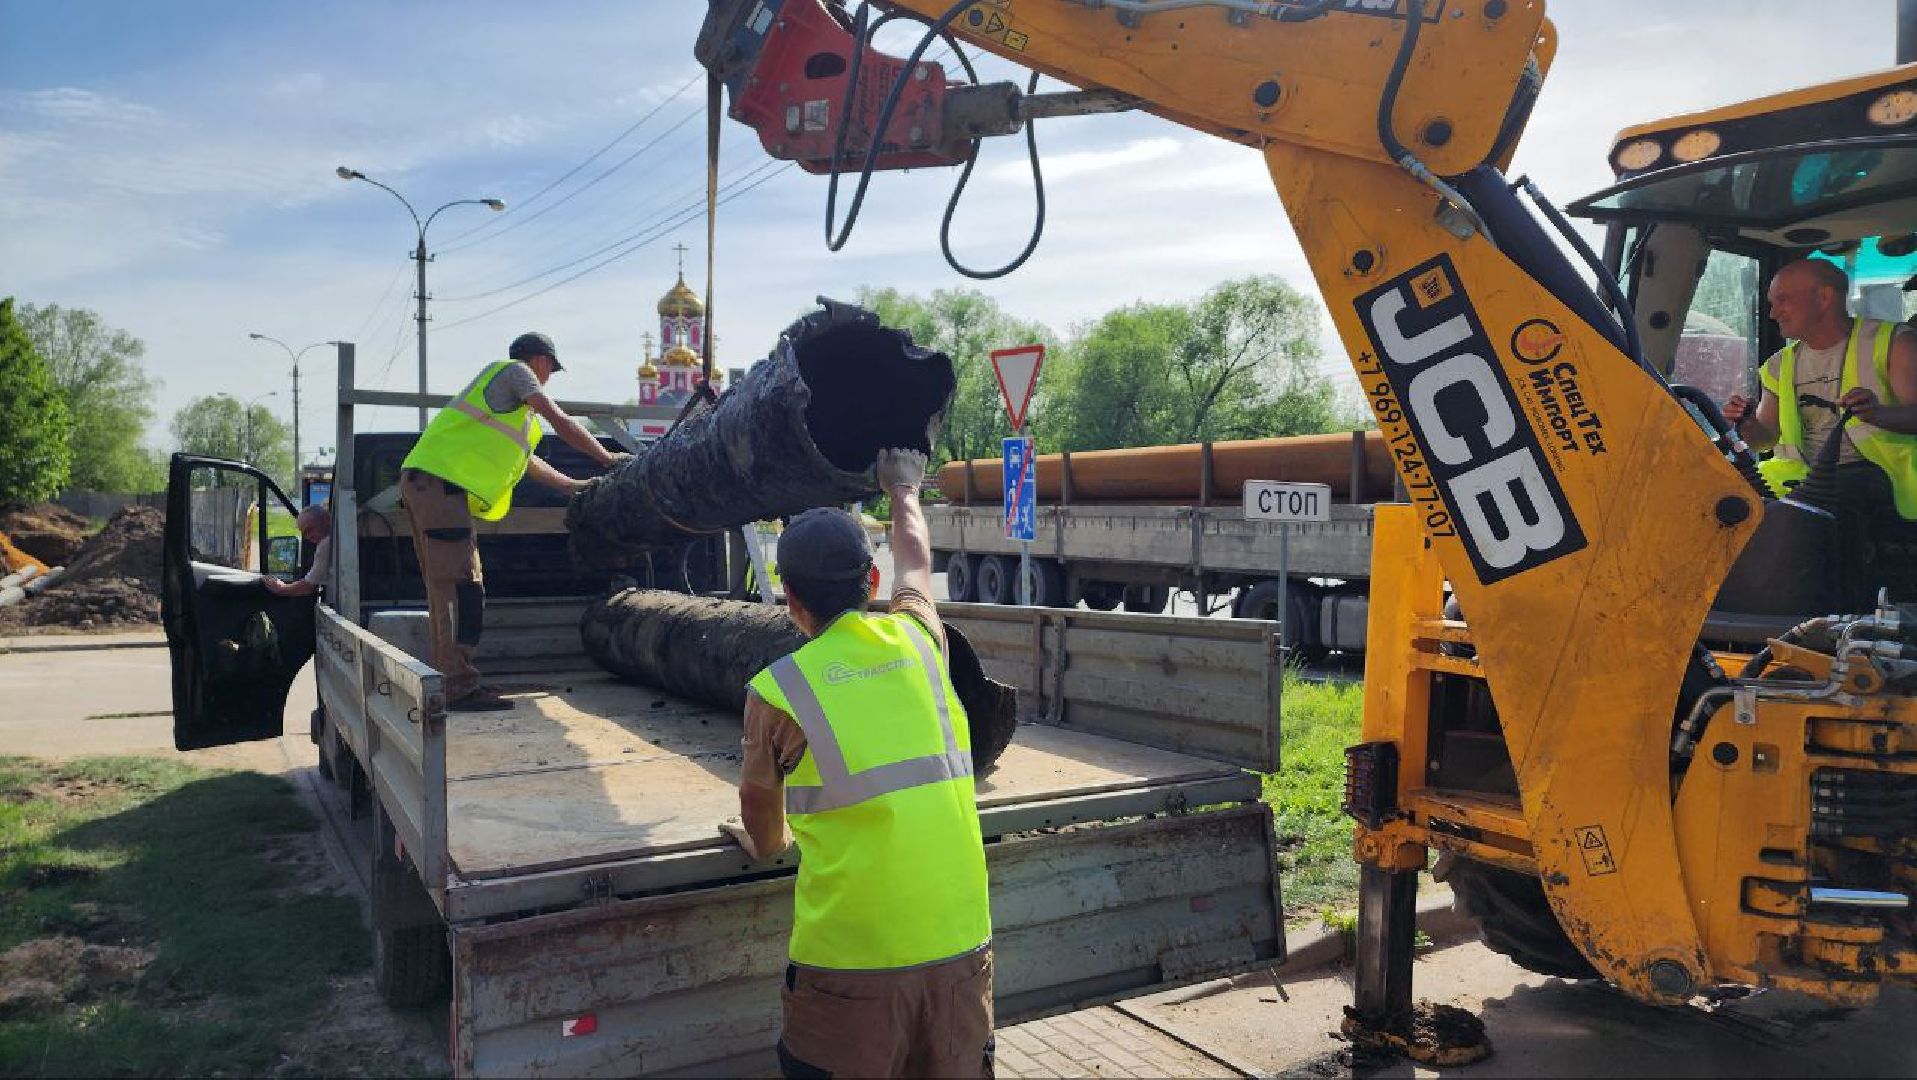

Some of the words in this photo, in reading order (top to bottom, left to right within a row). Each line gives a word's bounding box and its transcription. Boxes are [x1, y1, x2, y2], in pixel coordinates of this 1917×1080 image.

[1358, 351, 1383, 375] +7
[1370, 286, 1566, 569] JCB
[1258, 488, 1318, 515] СТОП
